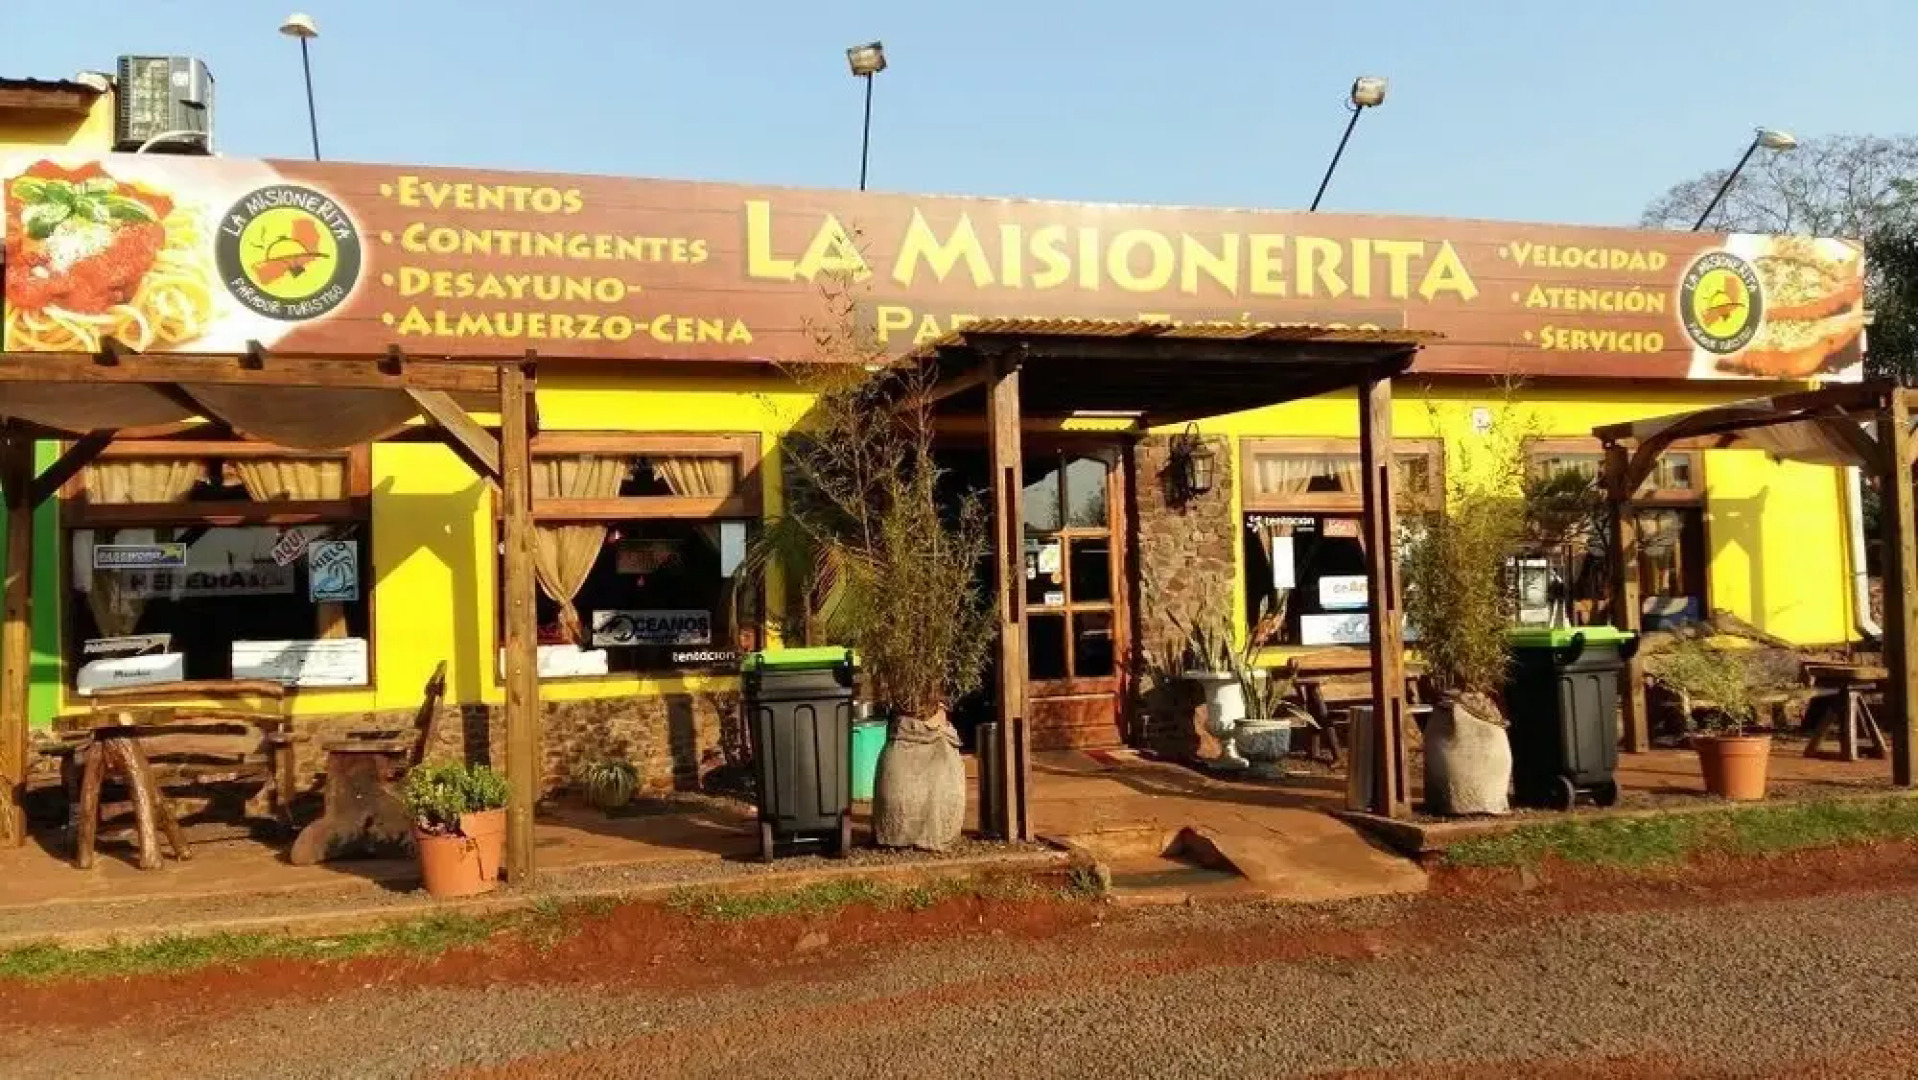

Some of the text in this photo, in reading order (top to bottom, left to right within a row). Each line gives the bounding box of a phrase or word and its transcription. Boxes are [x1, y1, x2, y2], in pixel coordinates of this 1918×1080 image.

[223, 187, 352, 239] LA MISIONERITA
[398, 174, 583, 214] EVENTOS
[402, 223, 708, 264] CONTINGENTES
[744, 198, 1480, 302] LA MISIONERITA
[1511, 241, 1668, 272] VELOCIDAD
[400, 267, 643, 305] DESAYUNO-
[1526, 284, 1666, 314] ATENCIÓN
[402, 308, 754, 345] ALMUERZO-CENA
[1540, 324, 1664, 354] SERVICIO
